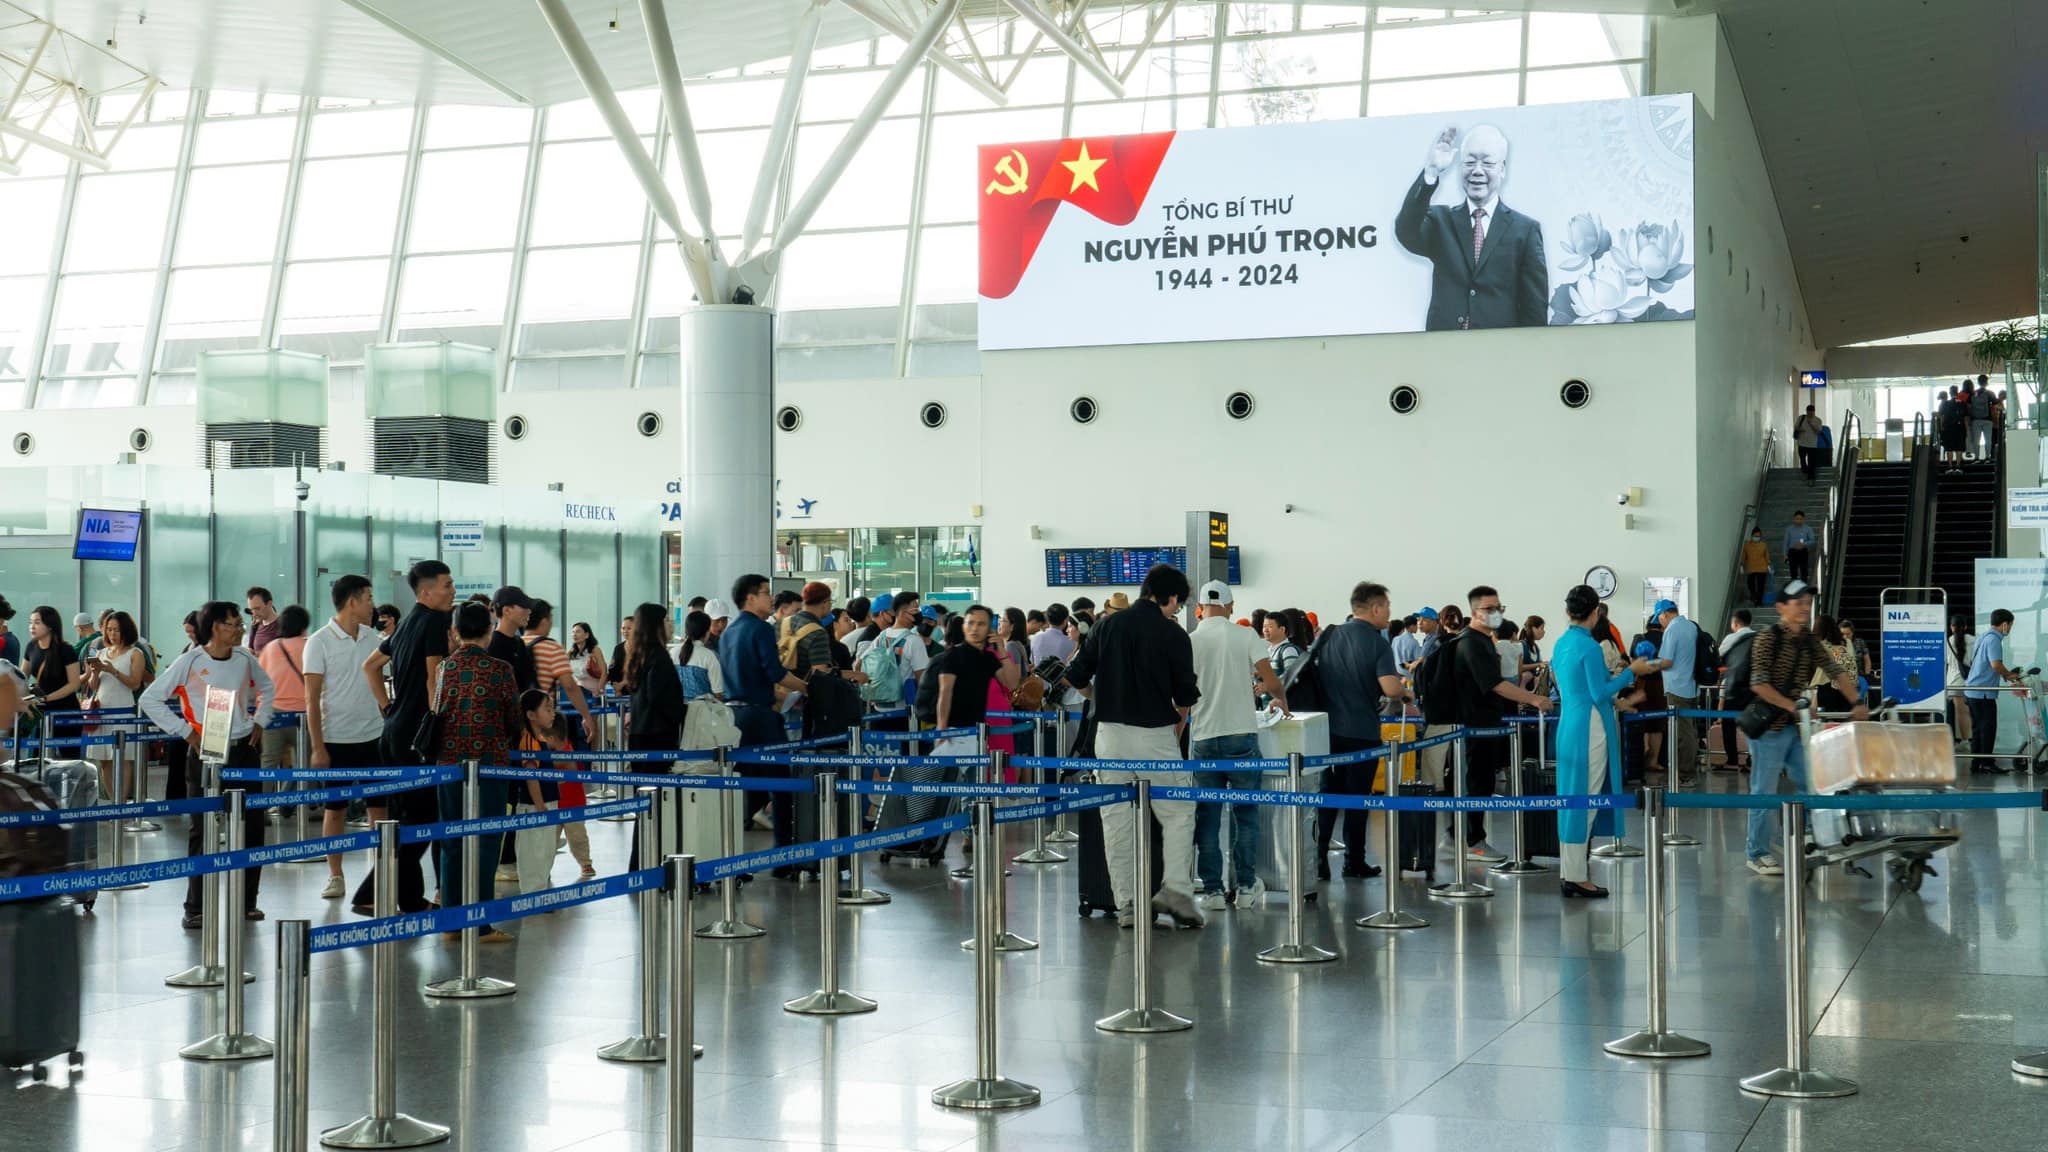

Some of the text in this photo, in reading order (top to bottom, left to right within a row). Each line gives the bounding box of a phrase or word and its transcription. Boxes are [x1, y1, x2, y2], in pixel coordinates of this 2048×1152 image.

[1163, 194, 1294, 220] TỔNG BÍ THƯ
[1085, 226, 1377, 262] NGUYỄN PHÚ TRỌNG
[1156, 268, 1212, 290] 1944
[1238, 264, 1298, 286] 2024
[566, 504, 616, 520] RECHECK
[86, 518, 110, 534] NIA
[1888, 612, 1910, 620] NIA
[630, 776, 679, 784] INTERNATIONAL
[941, 786, 1003, 794] INTERNATIONAL
[1194, 791, 1217, 800] ÀNG
[1220, 791, 1250, 800] KHÔNG
[1252, 792, 1276, 802] QUỐC
[1291, 794, 1306, 804] NỘI
[1364, 800, 1384, 808] N.I.A
[1424, 800, 1454, 808] NOIBAI
[1456, 800, 1526, 808] INTERNATIONAL
[1530, 799, 1568, 808] AIRPORT
[1588, 798, 1610, 806] N.I.A
[60, 812, 79, 820] NOIBAI
[80, 808, 120, 818] INTERNATIONAL
[122, 806, 144, 814] AIRPORT
[0, 884, 21, 894] N.I.A
[214, 856, 232, 868] N.I.A
[249, 848, 274, 864] NOIBAI
[274, 840, 328, 860] INTERNATIONAL
[328, 837, 356, 850] AIRPORT
[370, 833, 380, 844] N.I.
[340, 925, 369, 944] KHÔNG
[468, 908, 486, 922] N.I.A
[512, 898, 533, 914] NOIBAI
[534, 889, 581, 908] INTERNATIONAL
[582, 882, 607, 900] AIRPORT
[628, 877, 644, 888] N.I.A
